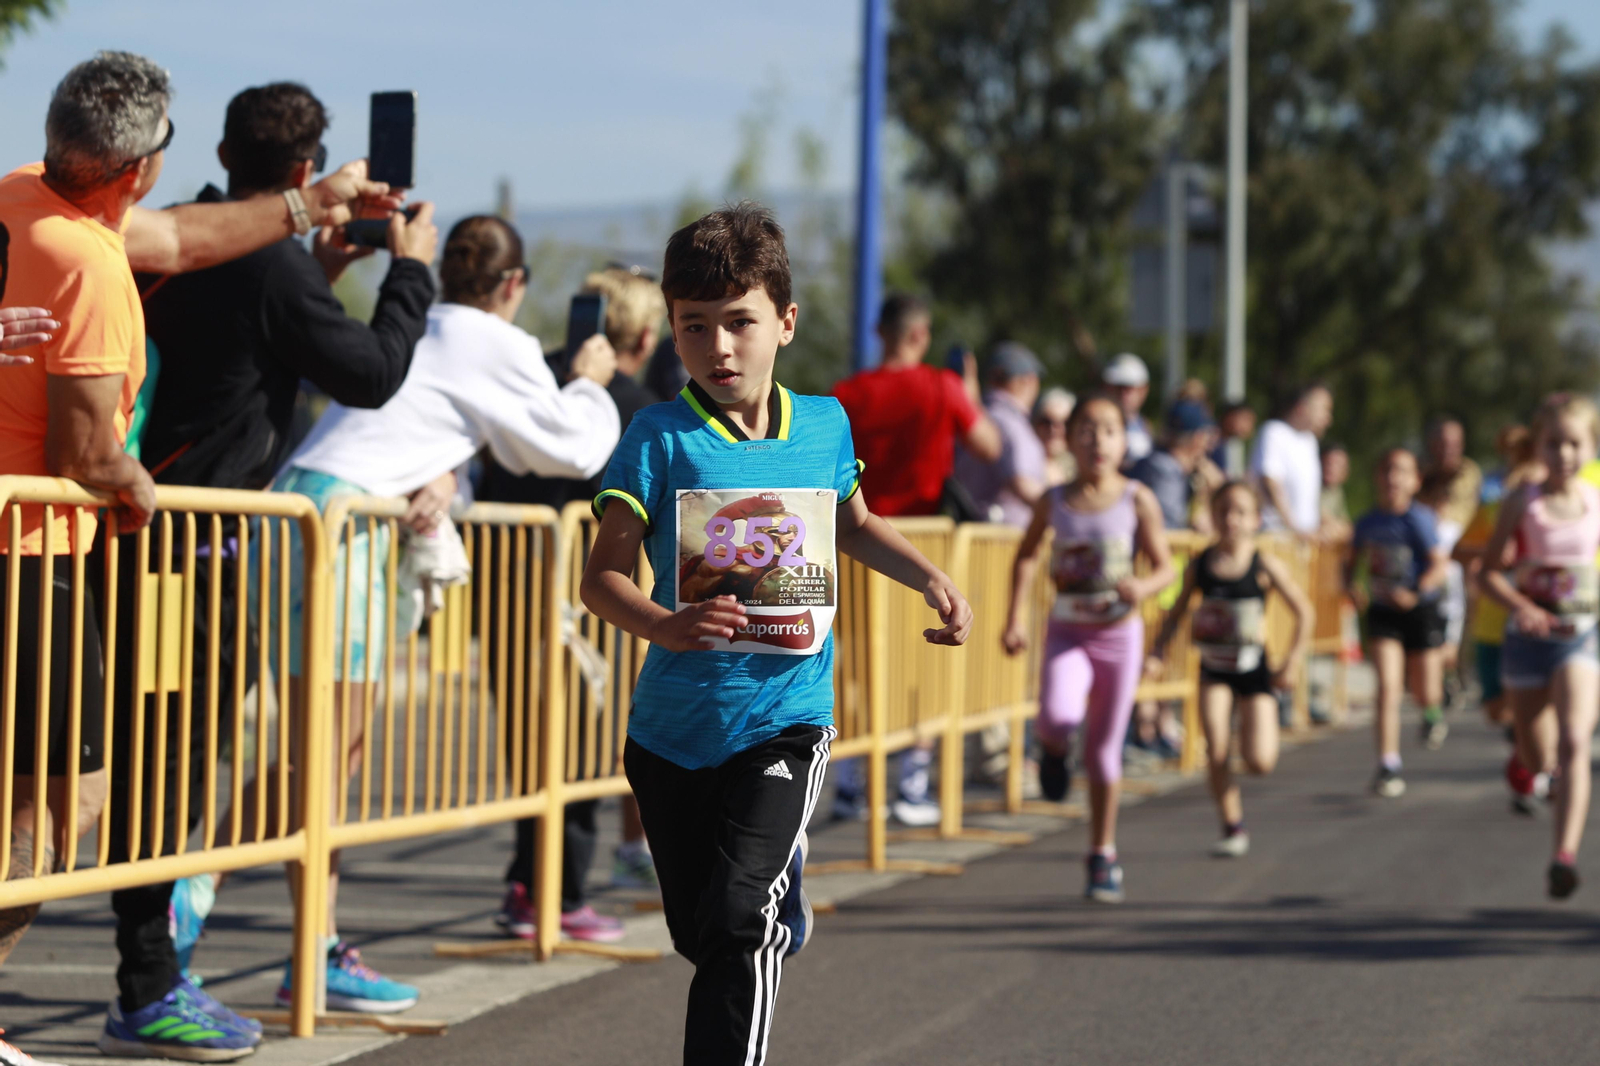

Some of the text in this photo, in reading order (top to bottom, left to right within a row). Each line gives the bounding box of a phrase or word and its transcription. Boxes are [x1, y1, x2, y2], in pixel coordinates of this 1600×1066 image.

[704, 516, 807, 568] 852
[779, 565, 826, 578] XIII
[763, 769, 793, 780] adidas
